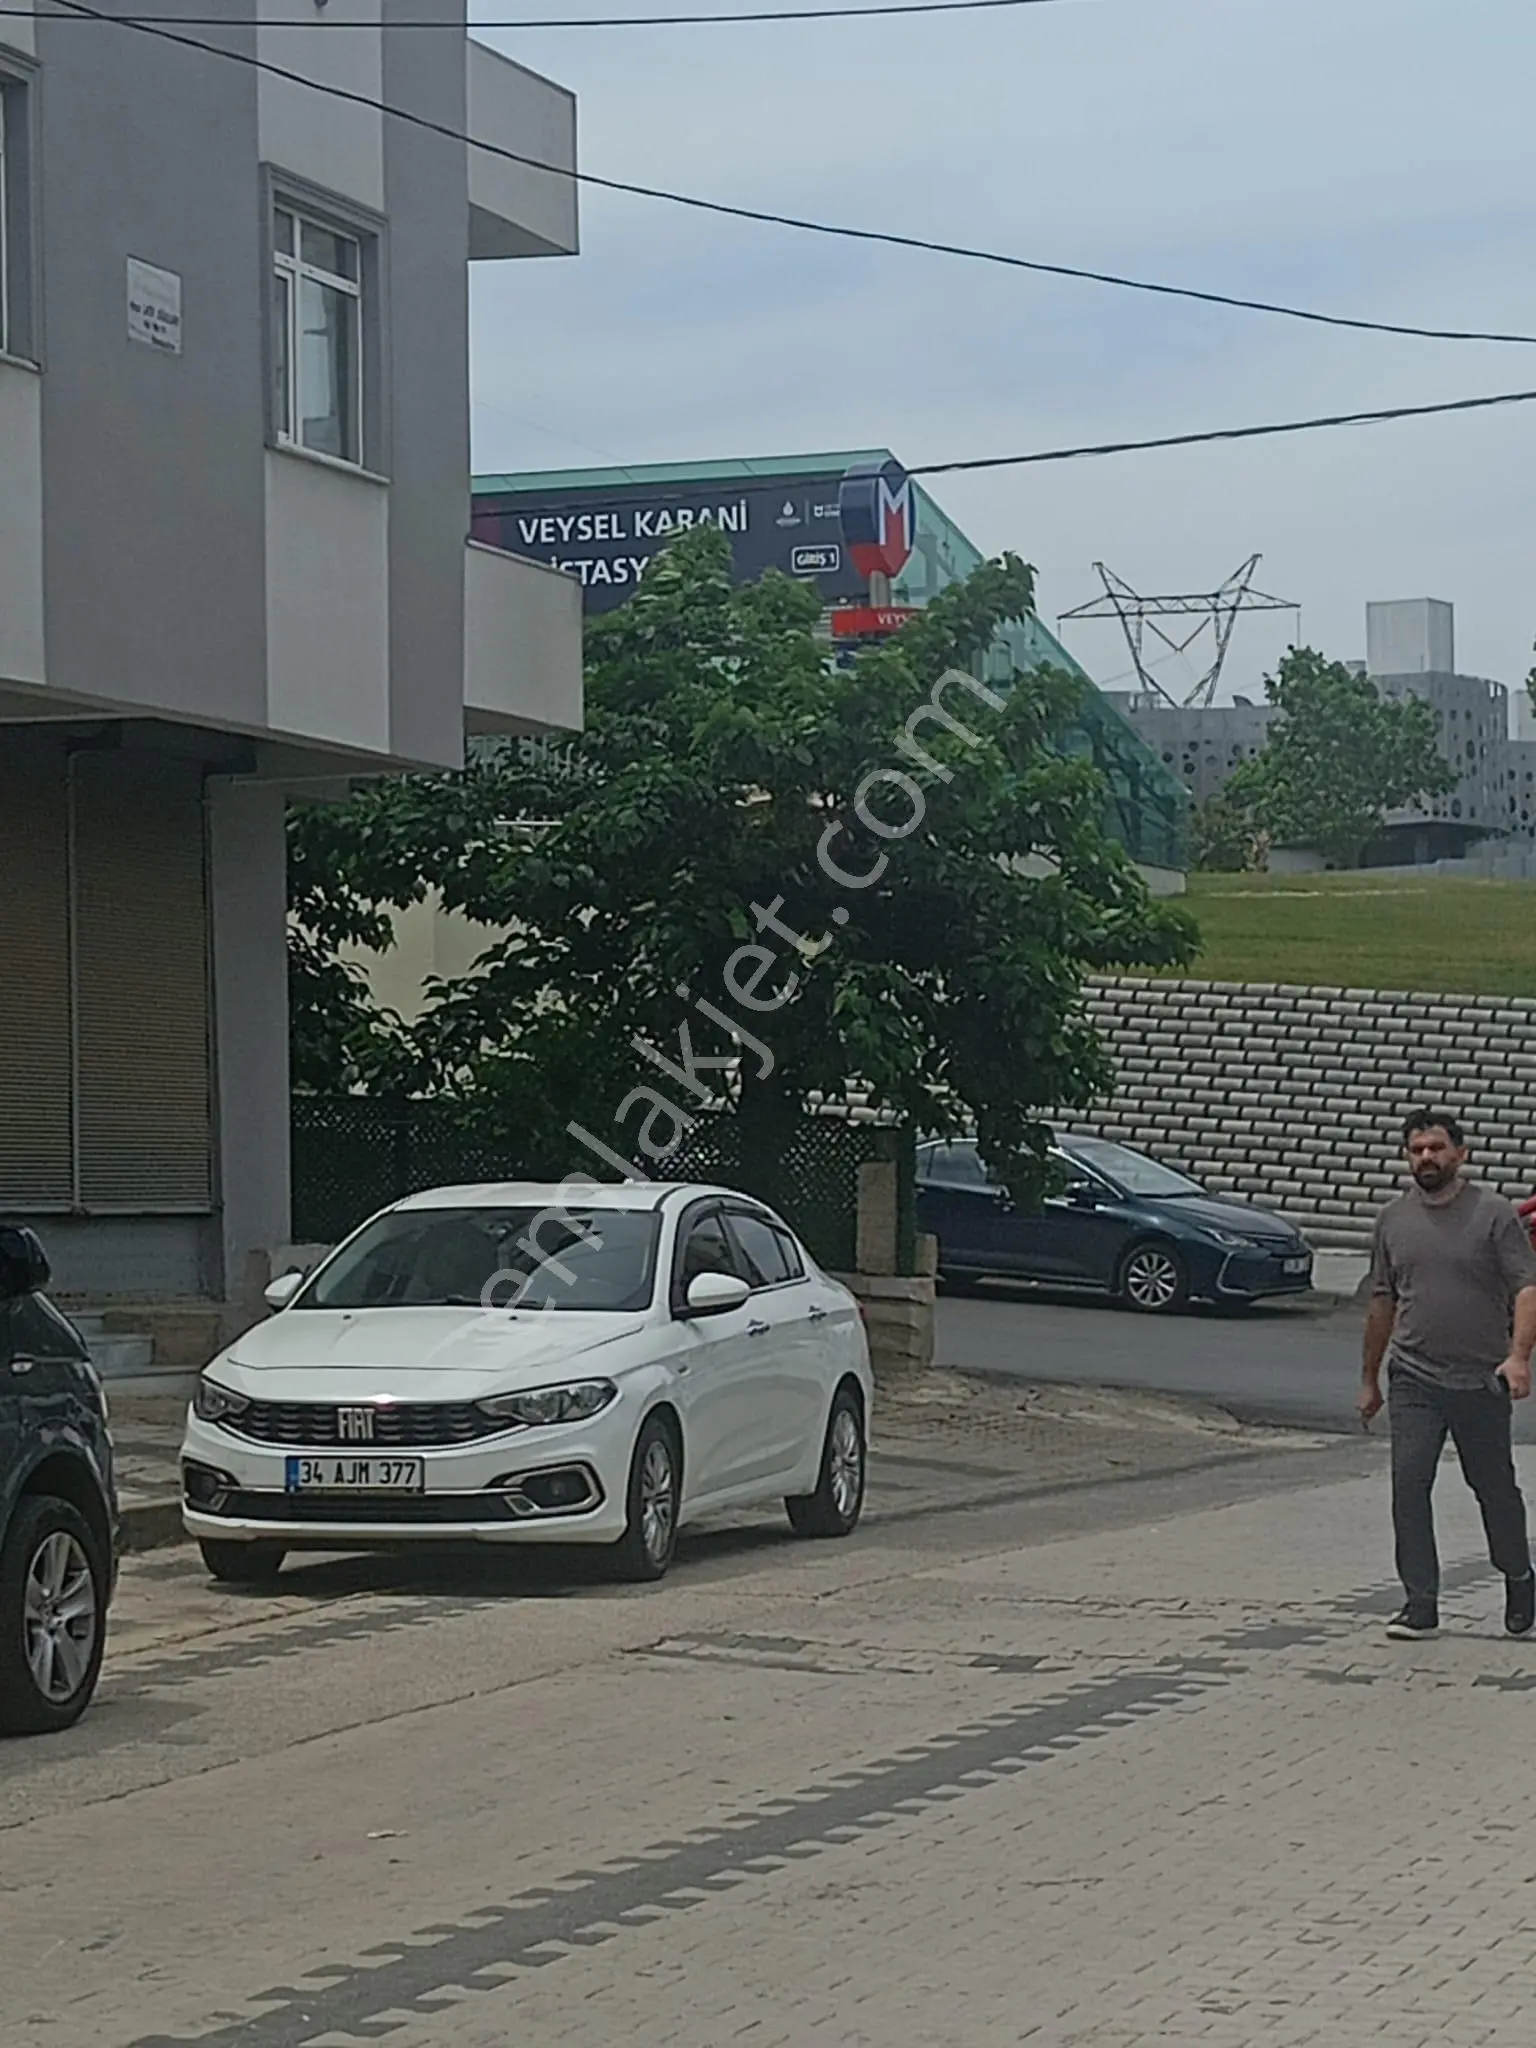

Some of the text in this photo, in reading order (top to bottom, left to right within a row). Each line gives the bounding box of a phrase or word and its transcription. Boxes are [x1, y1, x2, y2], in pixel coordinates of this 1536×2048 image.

[518, 499, 748, 545] VEYSEL KARANİ
[829, 551, 836, 565] 1
[337, 1407, 376, 1440] FIAT
[301, 1461, 416, 1485] 34 AJM 377
